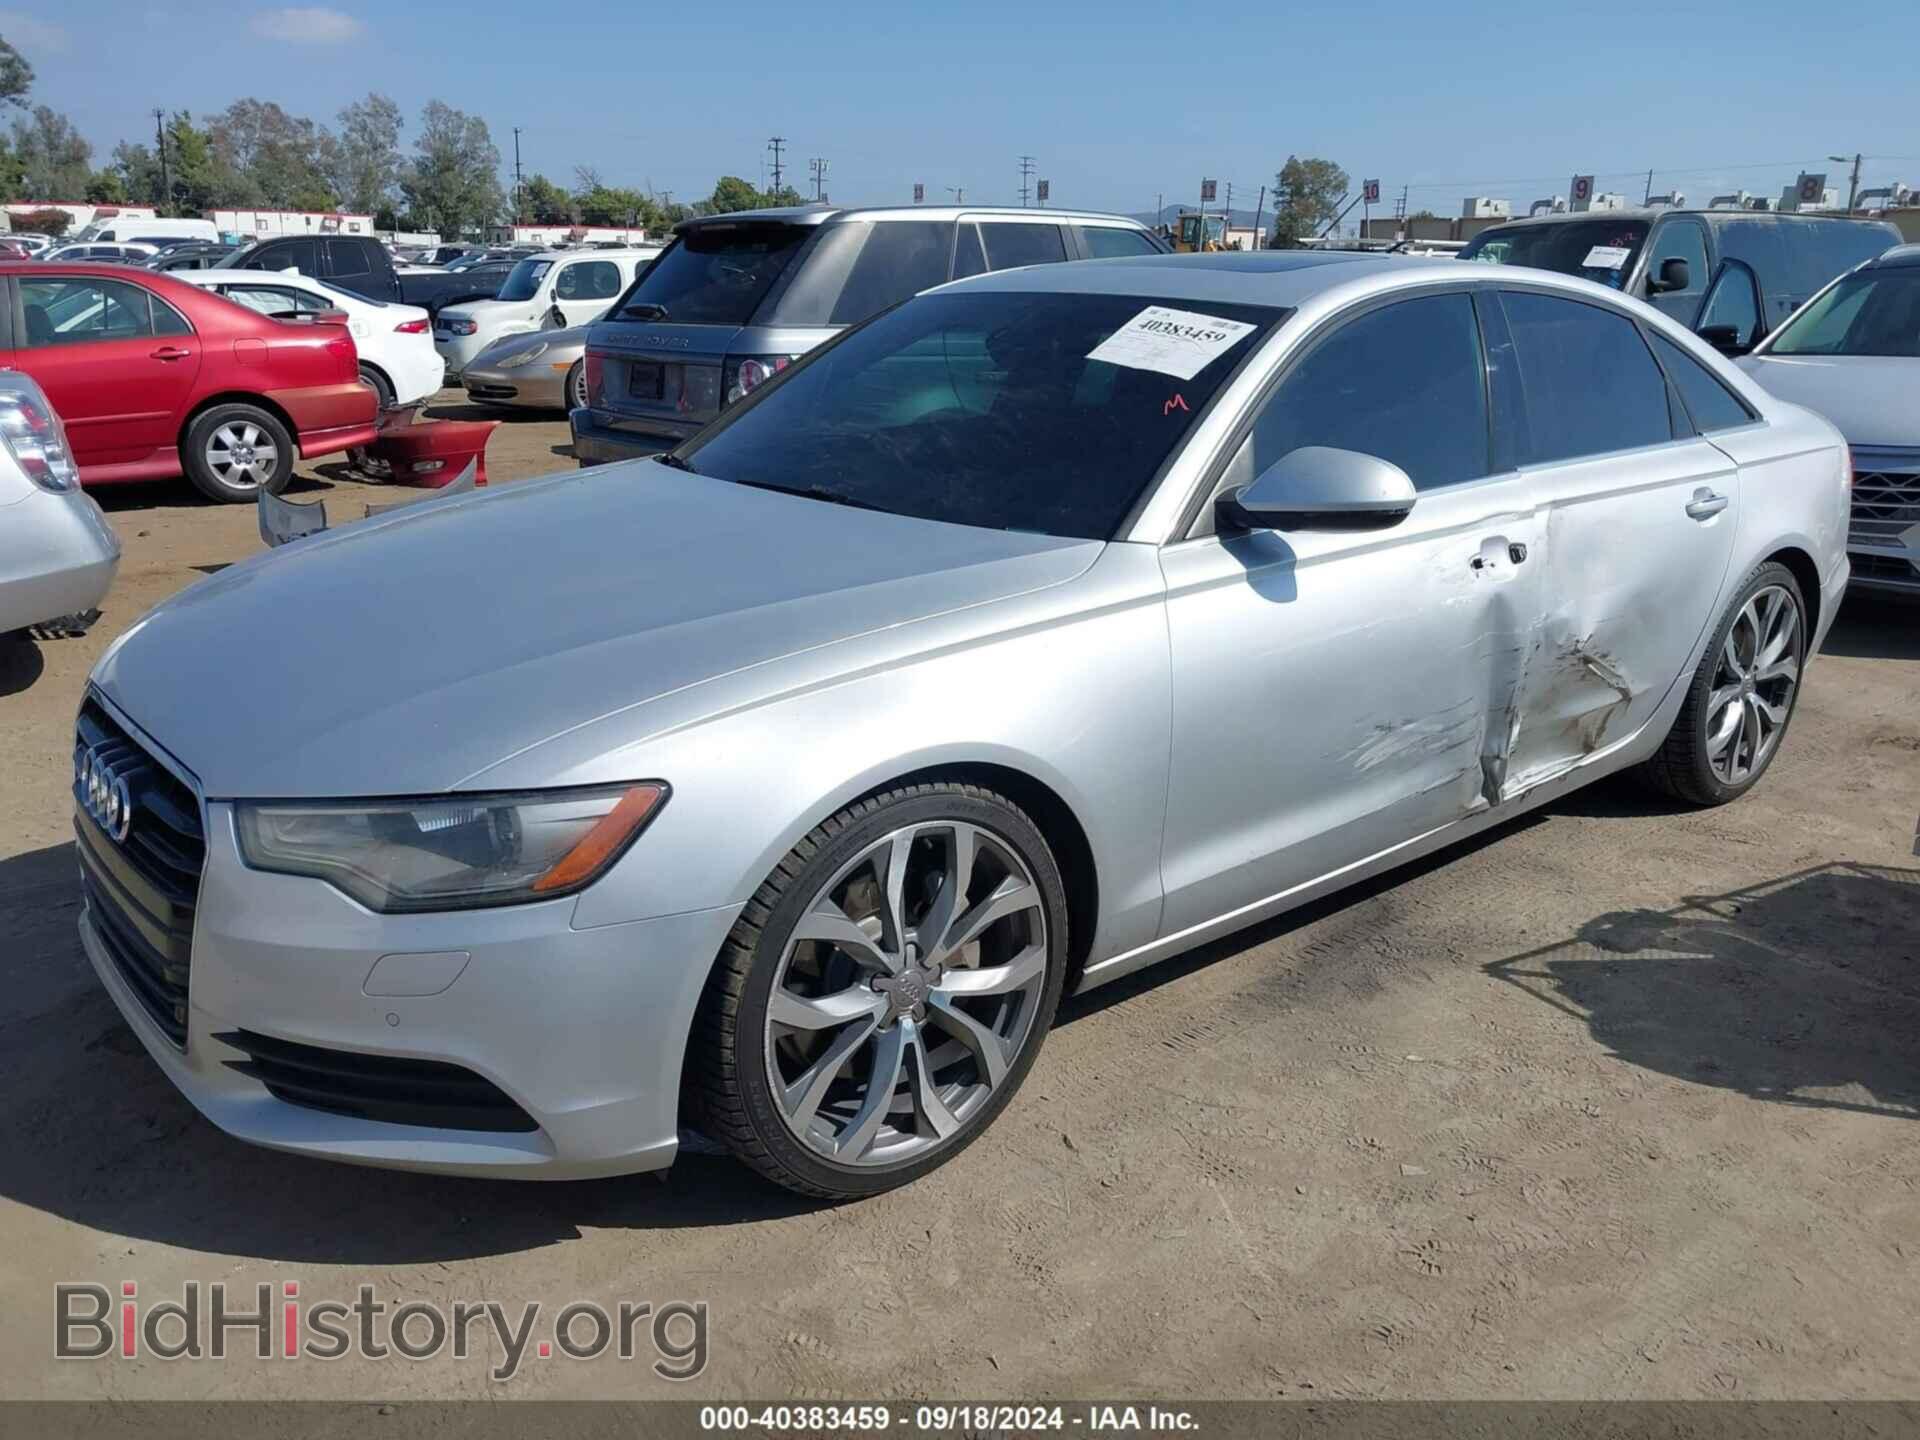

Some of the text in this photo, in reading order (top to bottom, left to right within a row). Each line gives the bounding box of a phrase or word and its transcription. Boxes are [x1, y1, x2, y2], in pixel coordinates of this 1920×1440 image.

[1575, 179, 1588, 200] 9
[1801, 177, 1818, 200] 8
[1139, 319, 1227, 343] 40383459
